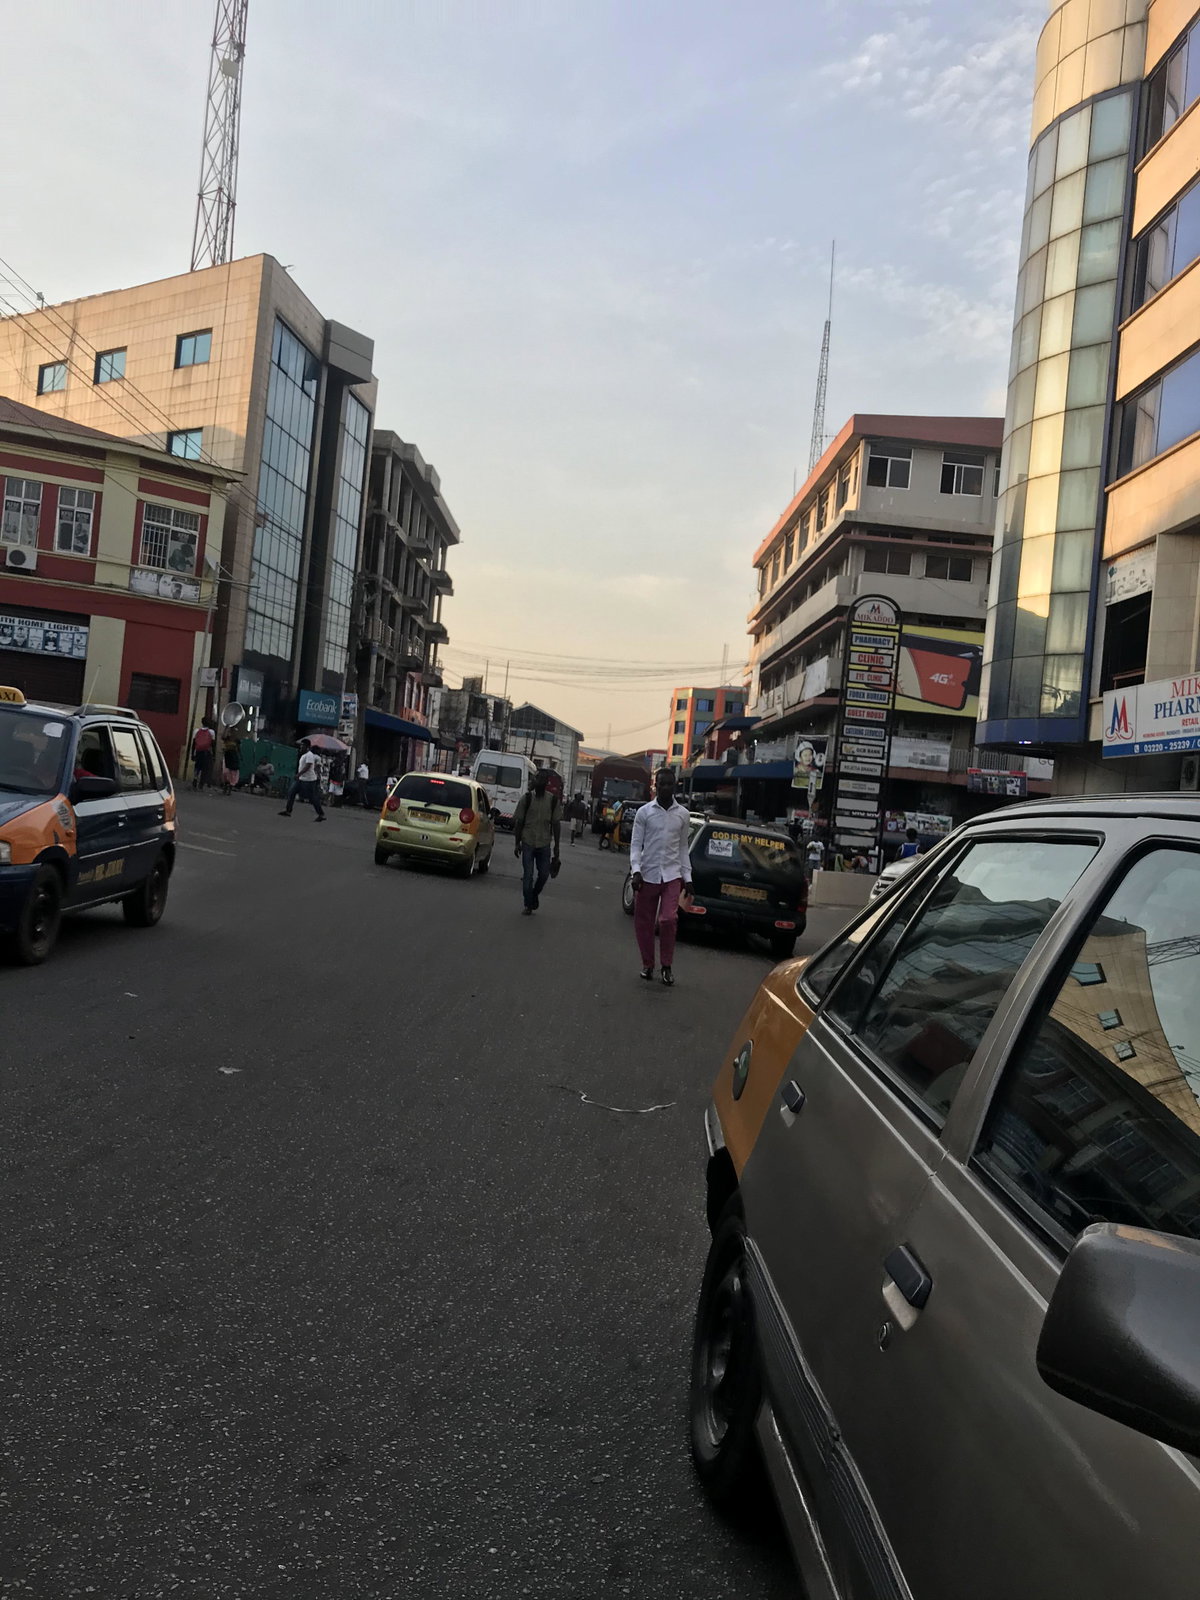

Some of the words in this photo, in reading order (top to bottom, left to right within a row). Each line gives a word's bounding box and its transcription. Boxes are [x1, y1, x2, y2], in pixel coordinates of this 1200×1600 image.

[857, 613, 894, 623] MIKADDO
[18, 619, 45, 628] HOME
[48, 623, 80, 632] LIGHTS
[854, 635, 891, 646] PHARMACY
[857, 654, 884, 665] CLINIC
[867, 673, 883, 683] CLINIC
[849, 690, 865, 699] FOREX
[866, 692, 887, 702] BUREAU
[306, 699, 337, 714] Ecobank
[847, 708, 865, 717] GUEST
[866, 711, 884, 720] HOUSE
[1181, 717, 1199, 727] RETAIL
[845, 727, 864, 736] CATERING
[864, 729, 883, 738] SERVICES
[1143, 744, 1163, 752] 03220
[1169, 740, 1190, 750] 25239
[712, 831, 729, 840] GOD
[740, 835, 753, 844] MY
[754, 836, 785, 851] HELPER
